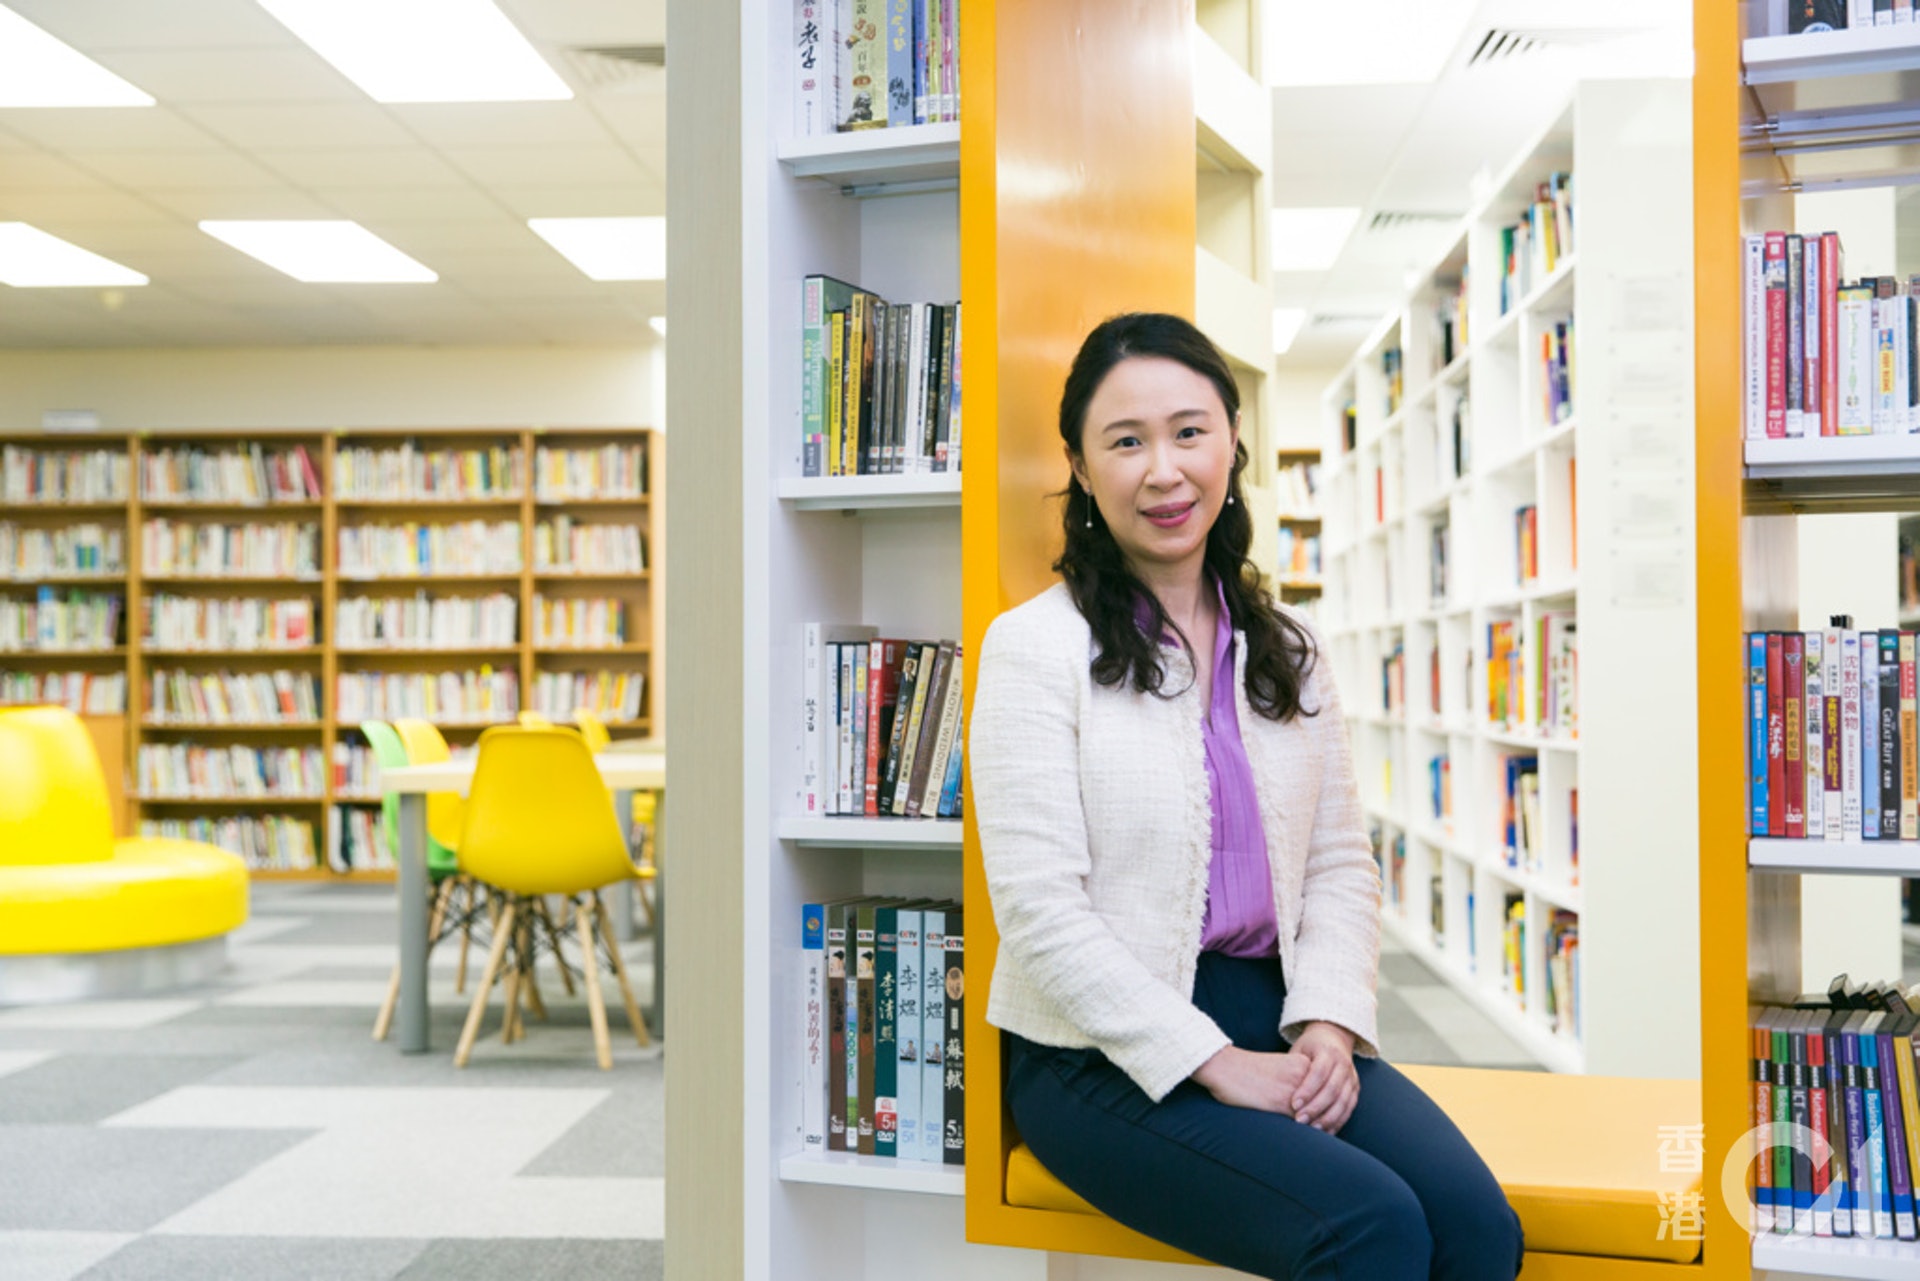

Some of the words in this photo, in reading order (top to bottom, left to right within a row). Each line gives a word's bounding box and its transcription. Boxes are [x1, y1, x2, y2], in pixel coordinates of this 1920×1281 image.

[1882, 708, 1892, 740] GREAT
[1882, 742, 1893, 765] RIFT
[878, 971, 896, 1043] 李清照
[899, 965, 918, 1018] 李煜
[926, 968, 944, 1019] 李煜
[1757, 1085, 1771, 1140] Geography
[1776, 1088, 1788, 1122] Biology
[1793, 1090, 1805, 1109] ICT
[1867, 1092, 1879, 1134] Business
[877, 1131, 895, 1142] DVD
